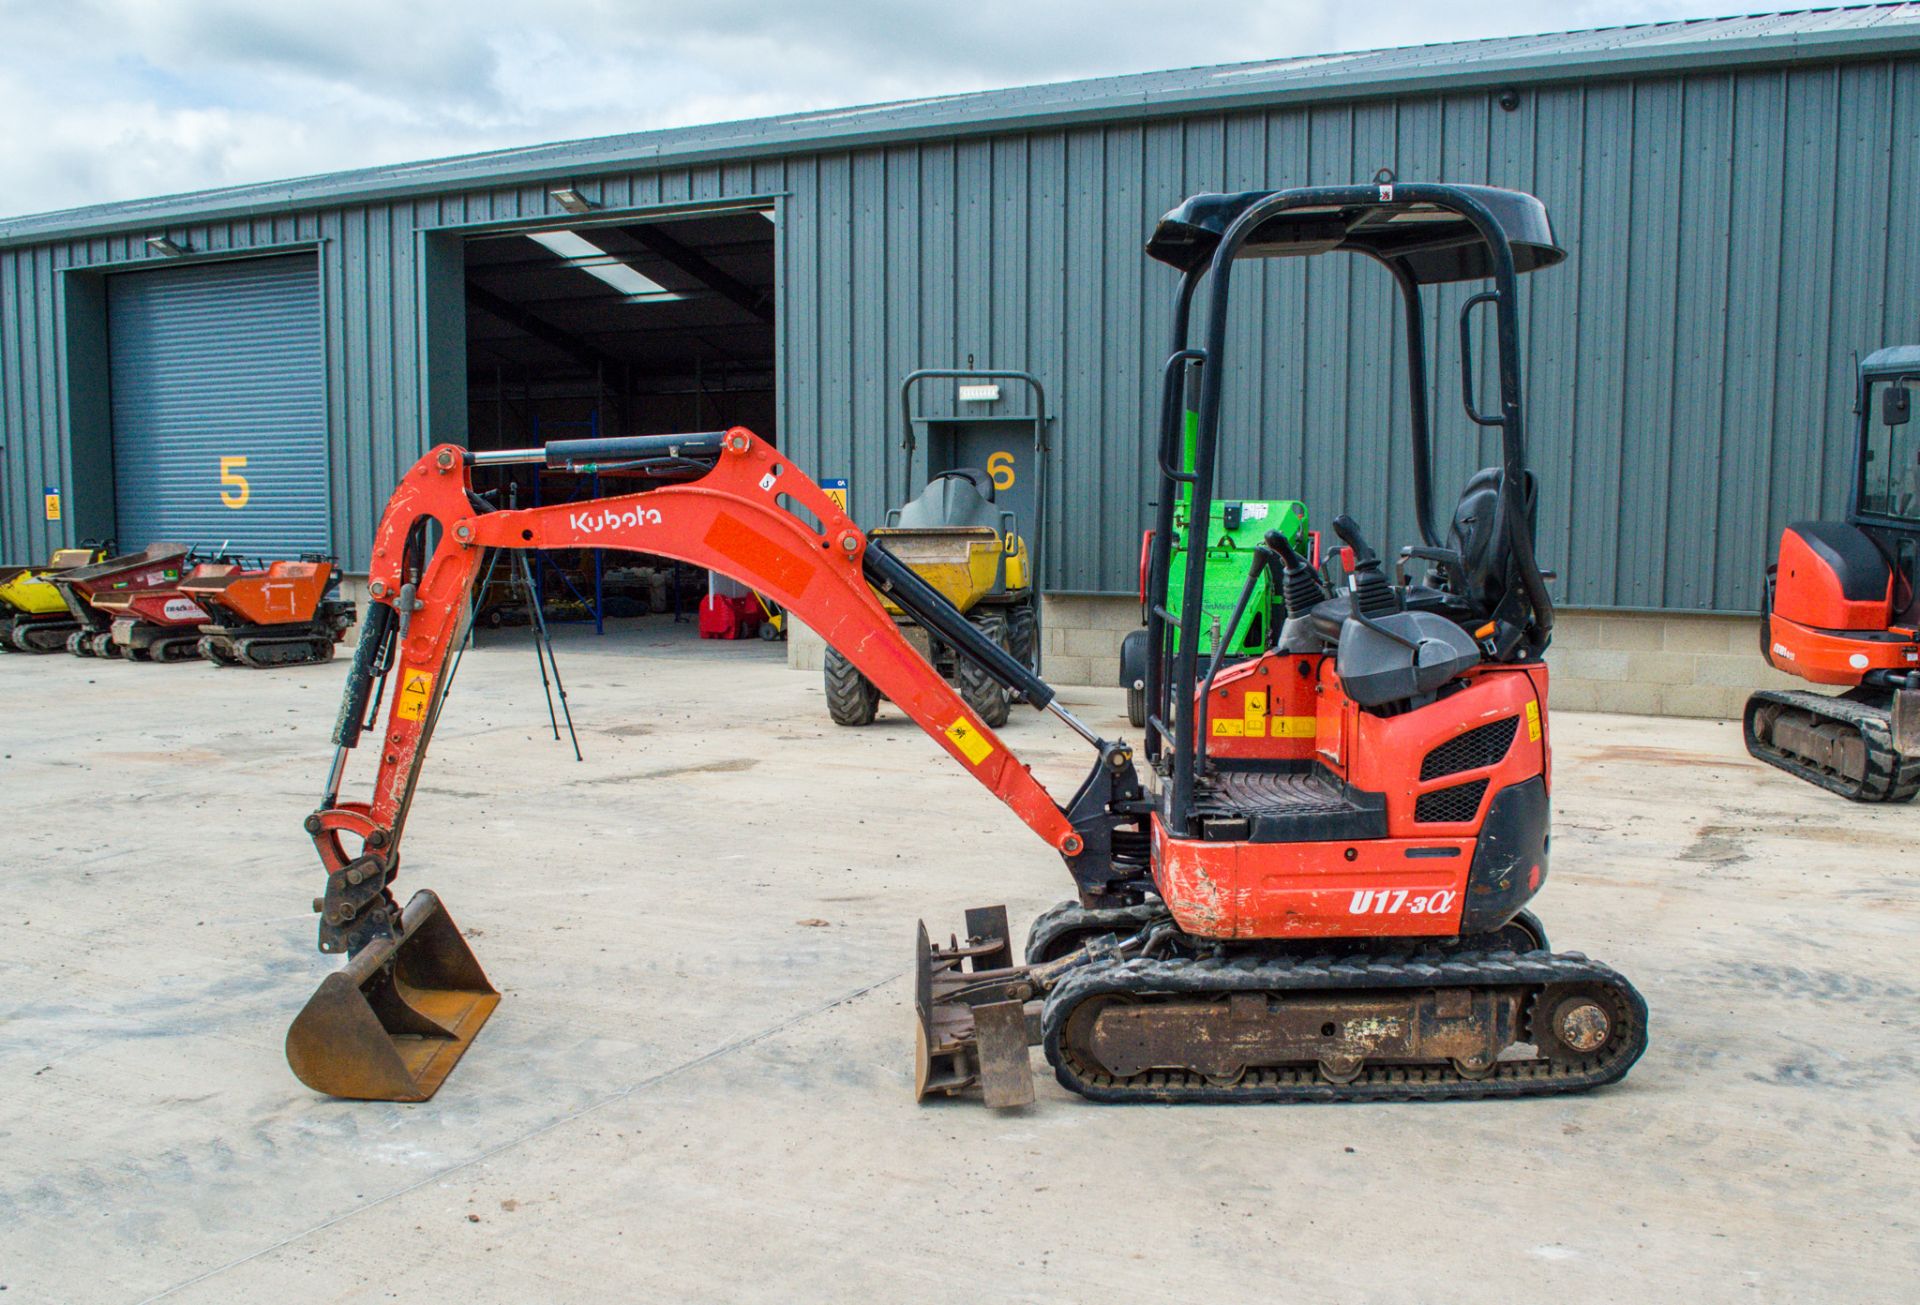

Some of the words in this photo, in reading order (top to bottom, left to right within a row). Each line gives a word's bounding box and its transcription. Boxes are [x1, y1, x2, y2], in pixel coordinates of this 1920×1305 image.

[221, 456, 249, 509] 5
[987, 451, 1015, 490] 6
[569, 505, 662, 534] Kubota
